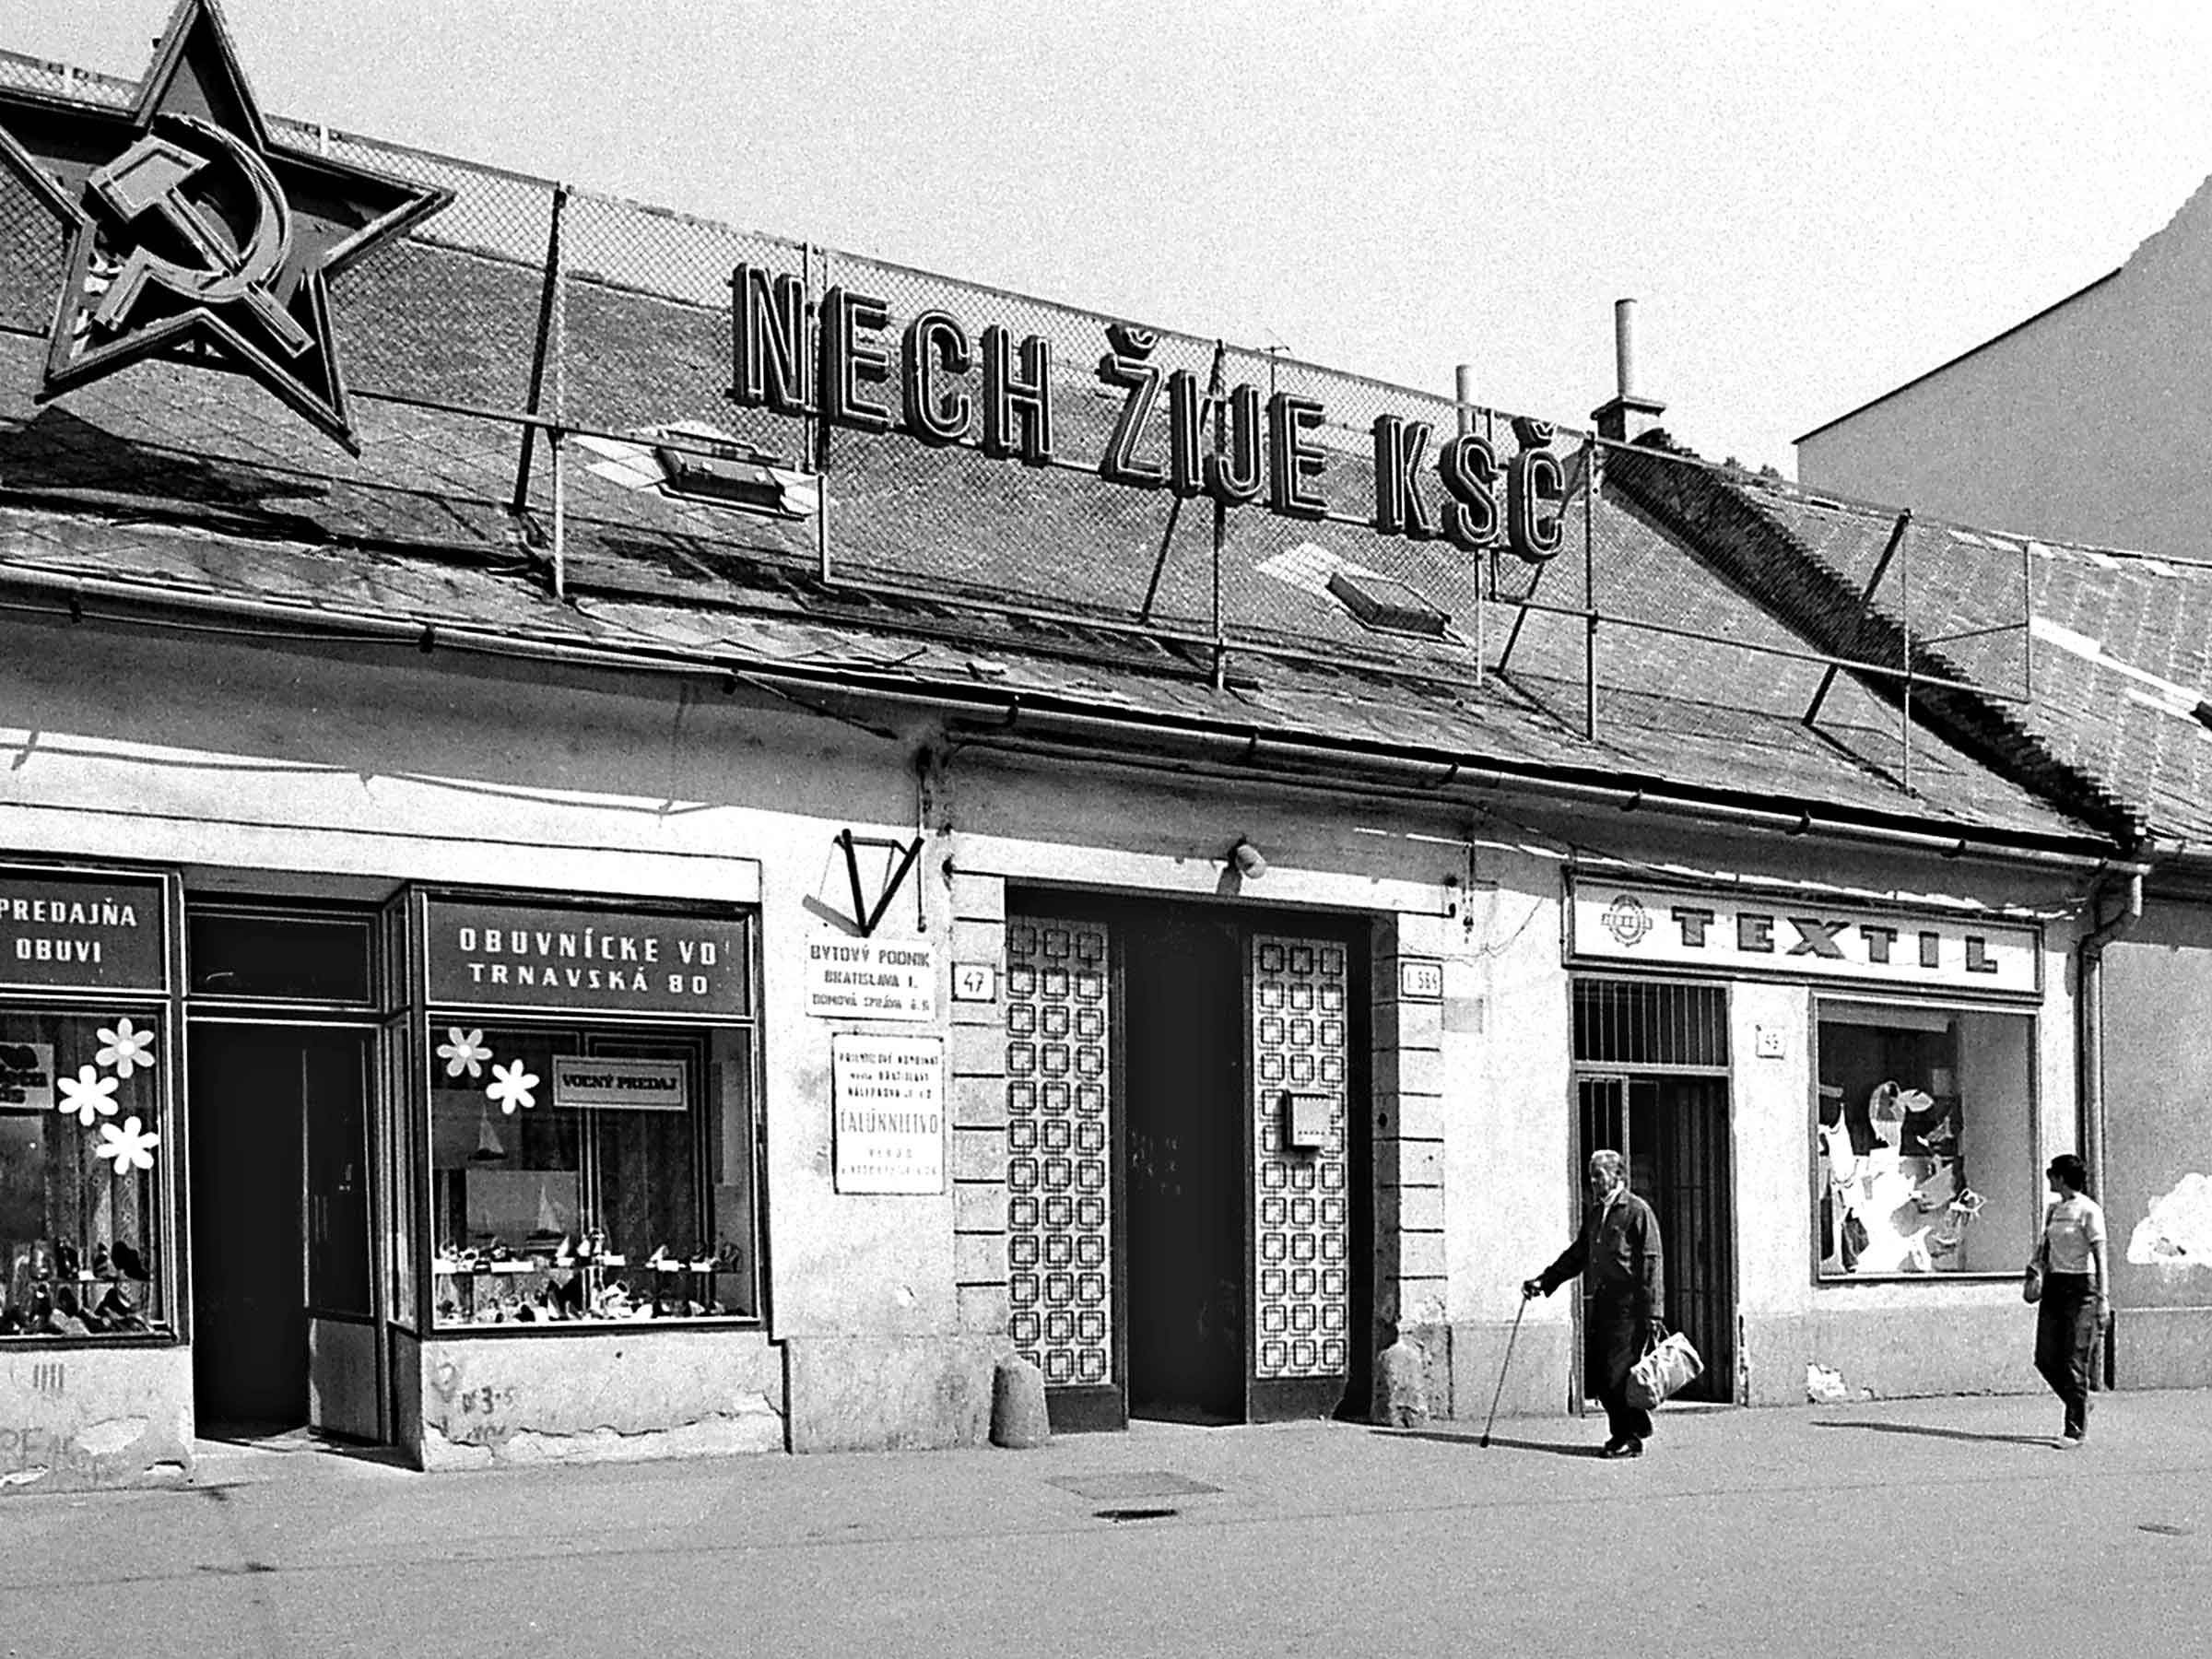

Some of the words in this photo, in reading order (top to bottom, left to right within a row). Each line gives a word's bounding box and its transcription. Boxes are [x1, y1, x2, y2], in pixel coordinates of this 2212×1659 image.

[727, 263, 1053, 466] NECH
[1098, 323, 1331, 520] ŽIJE
[1373, 414, 1569, 563] KSČ
[0, 898, 138, 927] PREDAJŇA
[16, 938, 101, 963] OBUVI
[459, 926, 659, 962] OBUVNÍCKE
[1671, 906, 1998, 974] TEXTIL
[810, 944, 870, 962] BYTOVÝ
[878, 949, 931, 968] PODNIK
[468, 962, 649, 992] TRNAVSKÁ
[668, 974, 708, 994] 80
[824, 970, 900, 987] BRATISLAVA
[963, 972, 985, 993] 47
